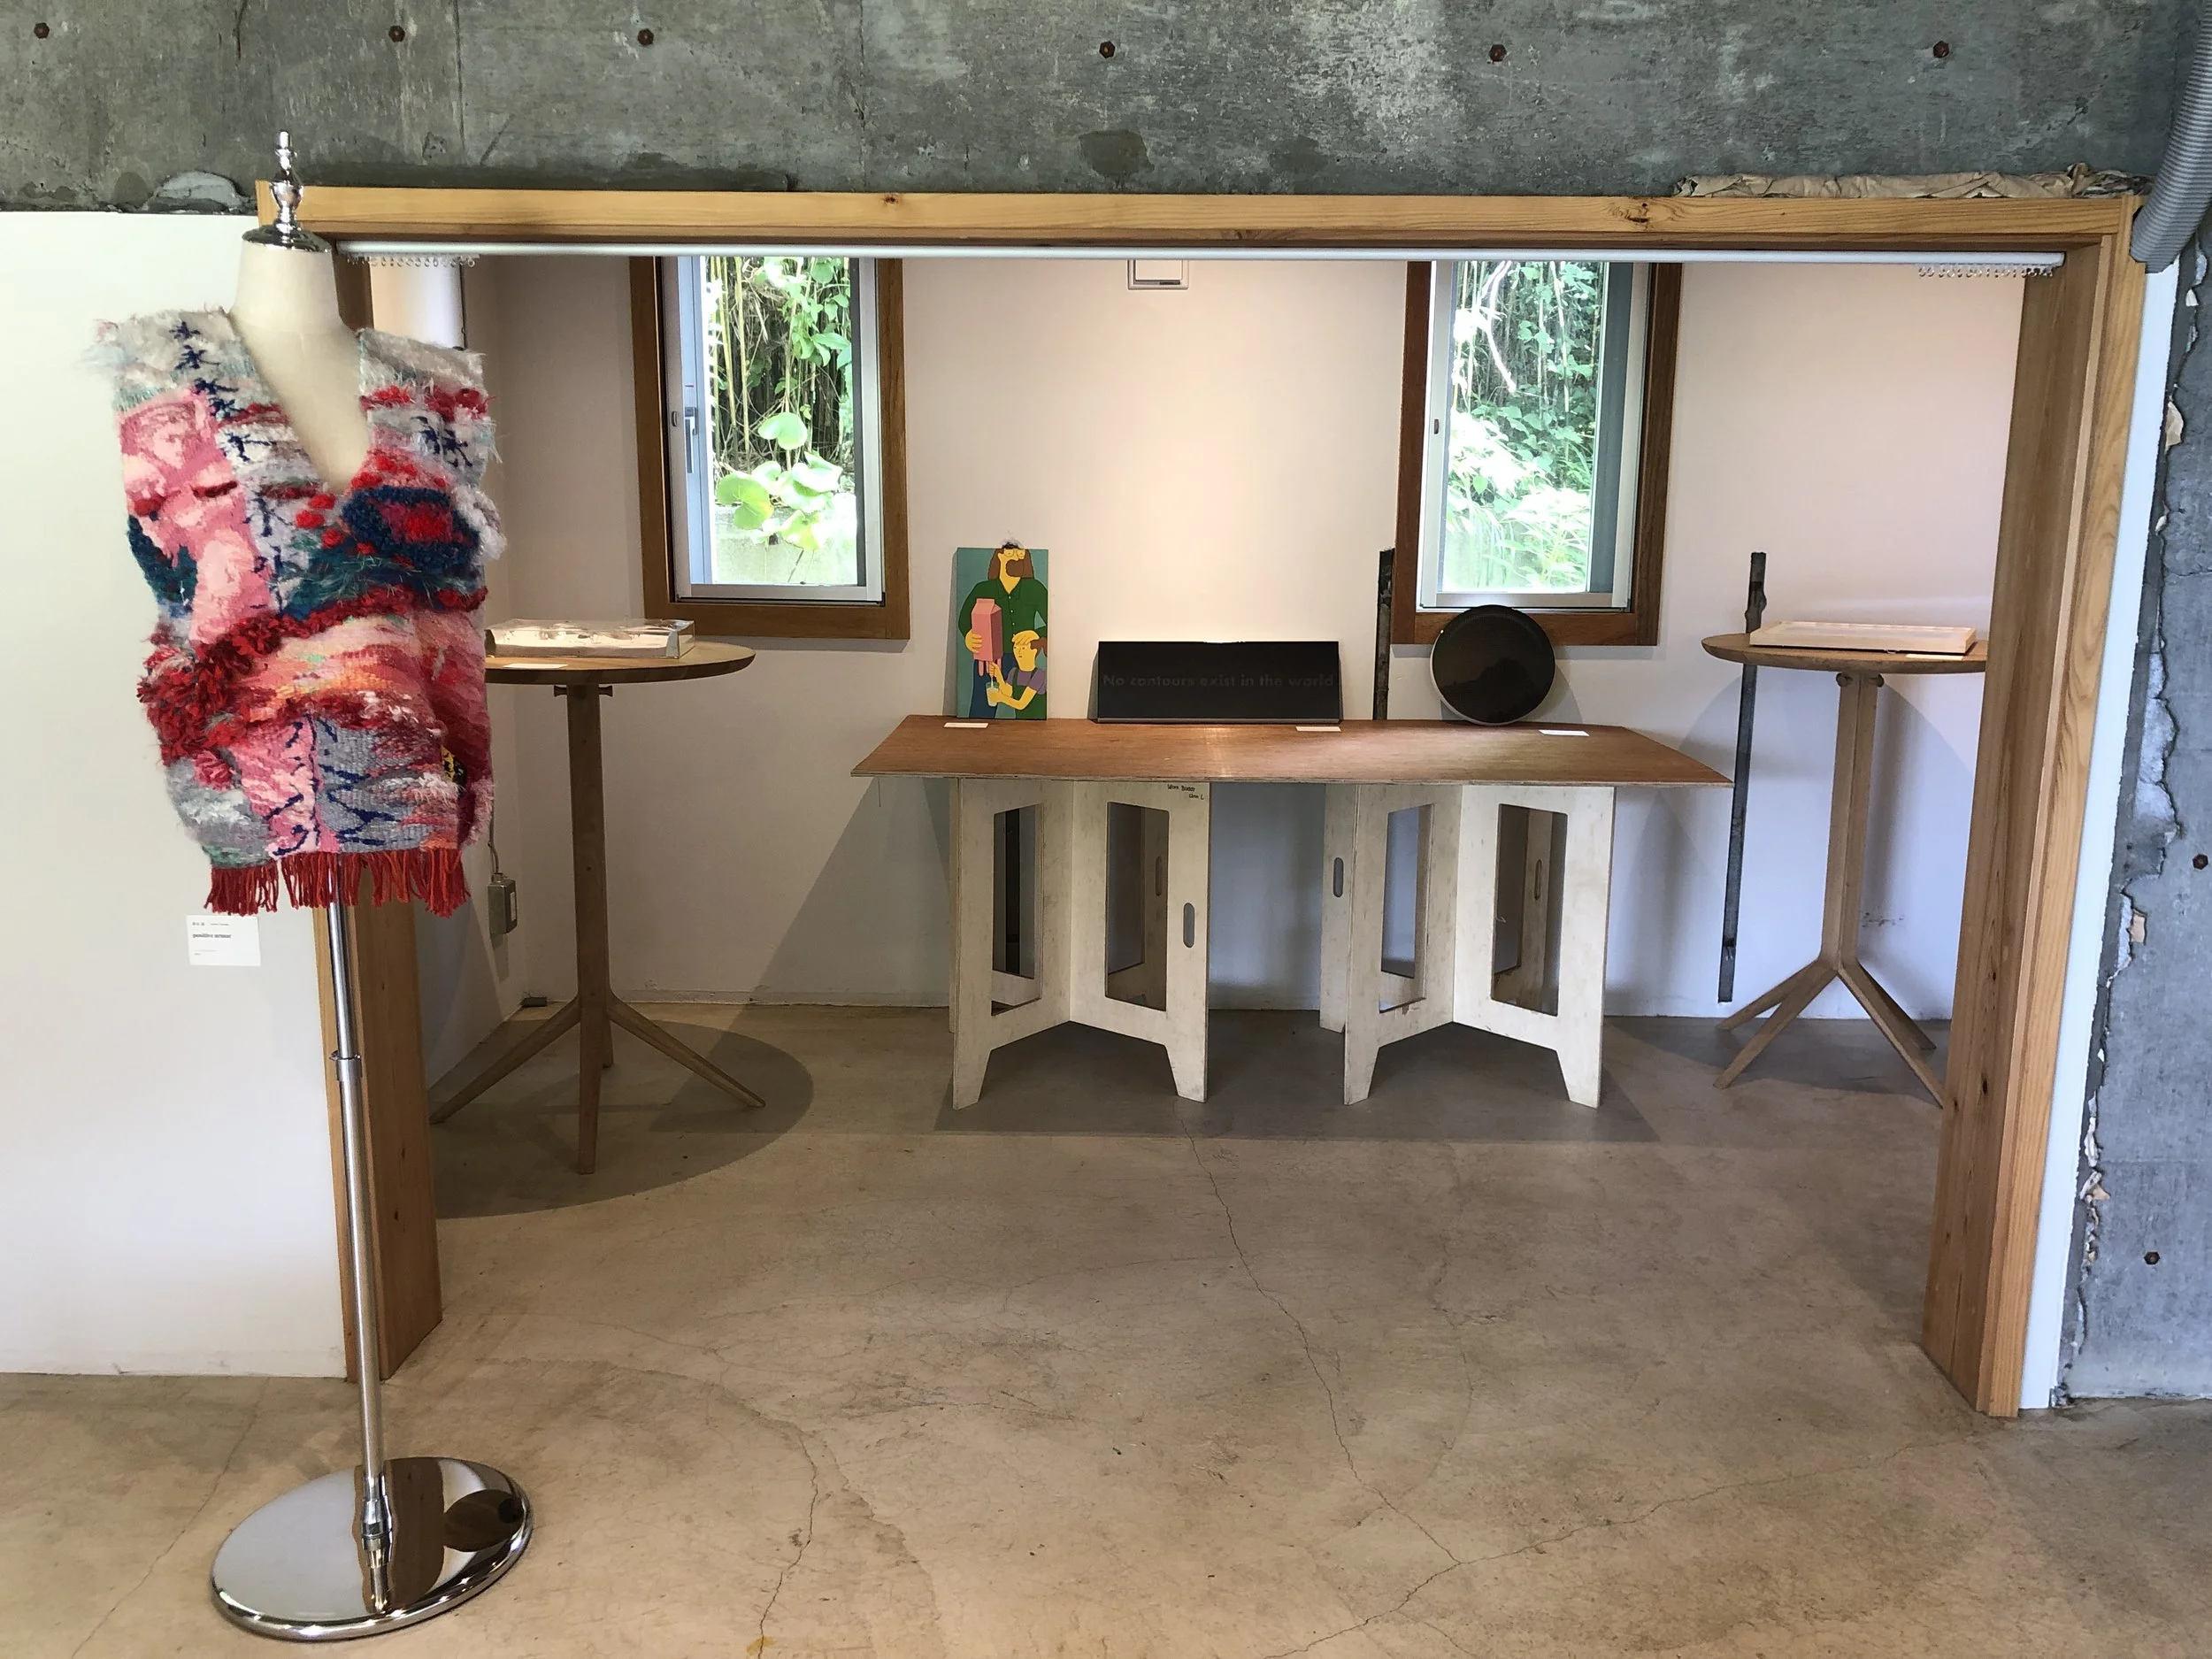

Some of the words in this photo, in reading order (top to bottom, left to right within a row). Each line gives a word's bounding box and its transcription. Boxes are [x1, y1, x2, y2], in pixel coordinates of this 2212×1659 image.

[1102, 675, 1125, 687] No
[1131, 675, 1194, 687] contours
[1200, 674, 1235, 687] exist
[1240, 674, 1254, 687] in
[1260, 674, 1282, 687] the
[1289, 674, 1333, 687] world
